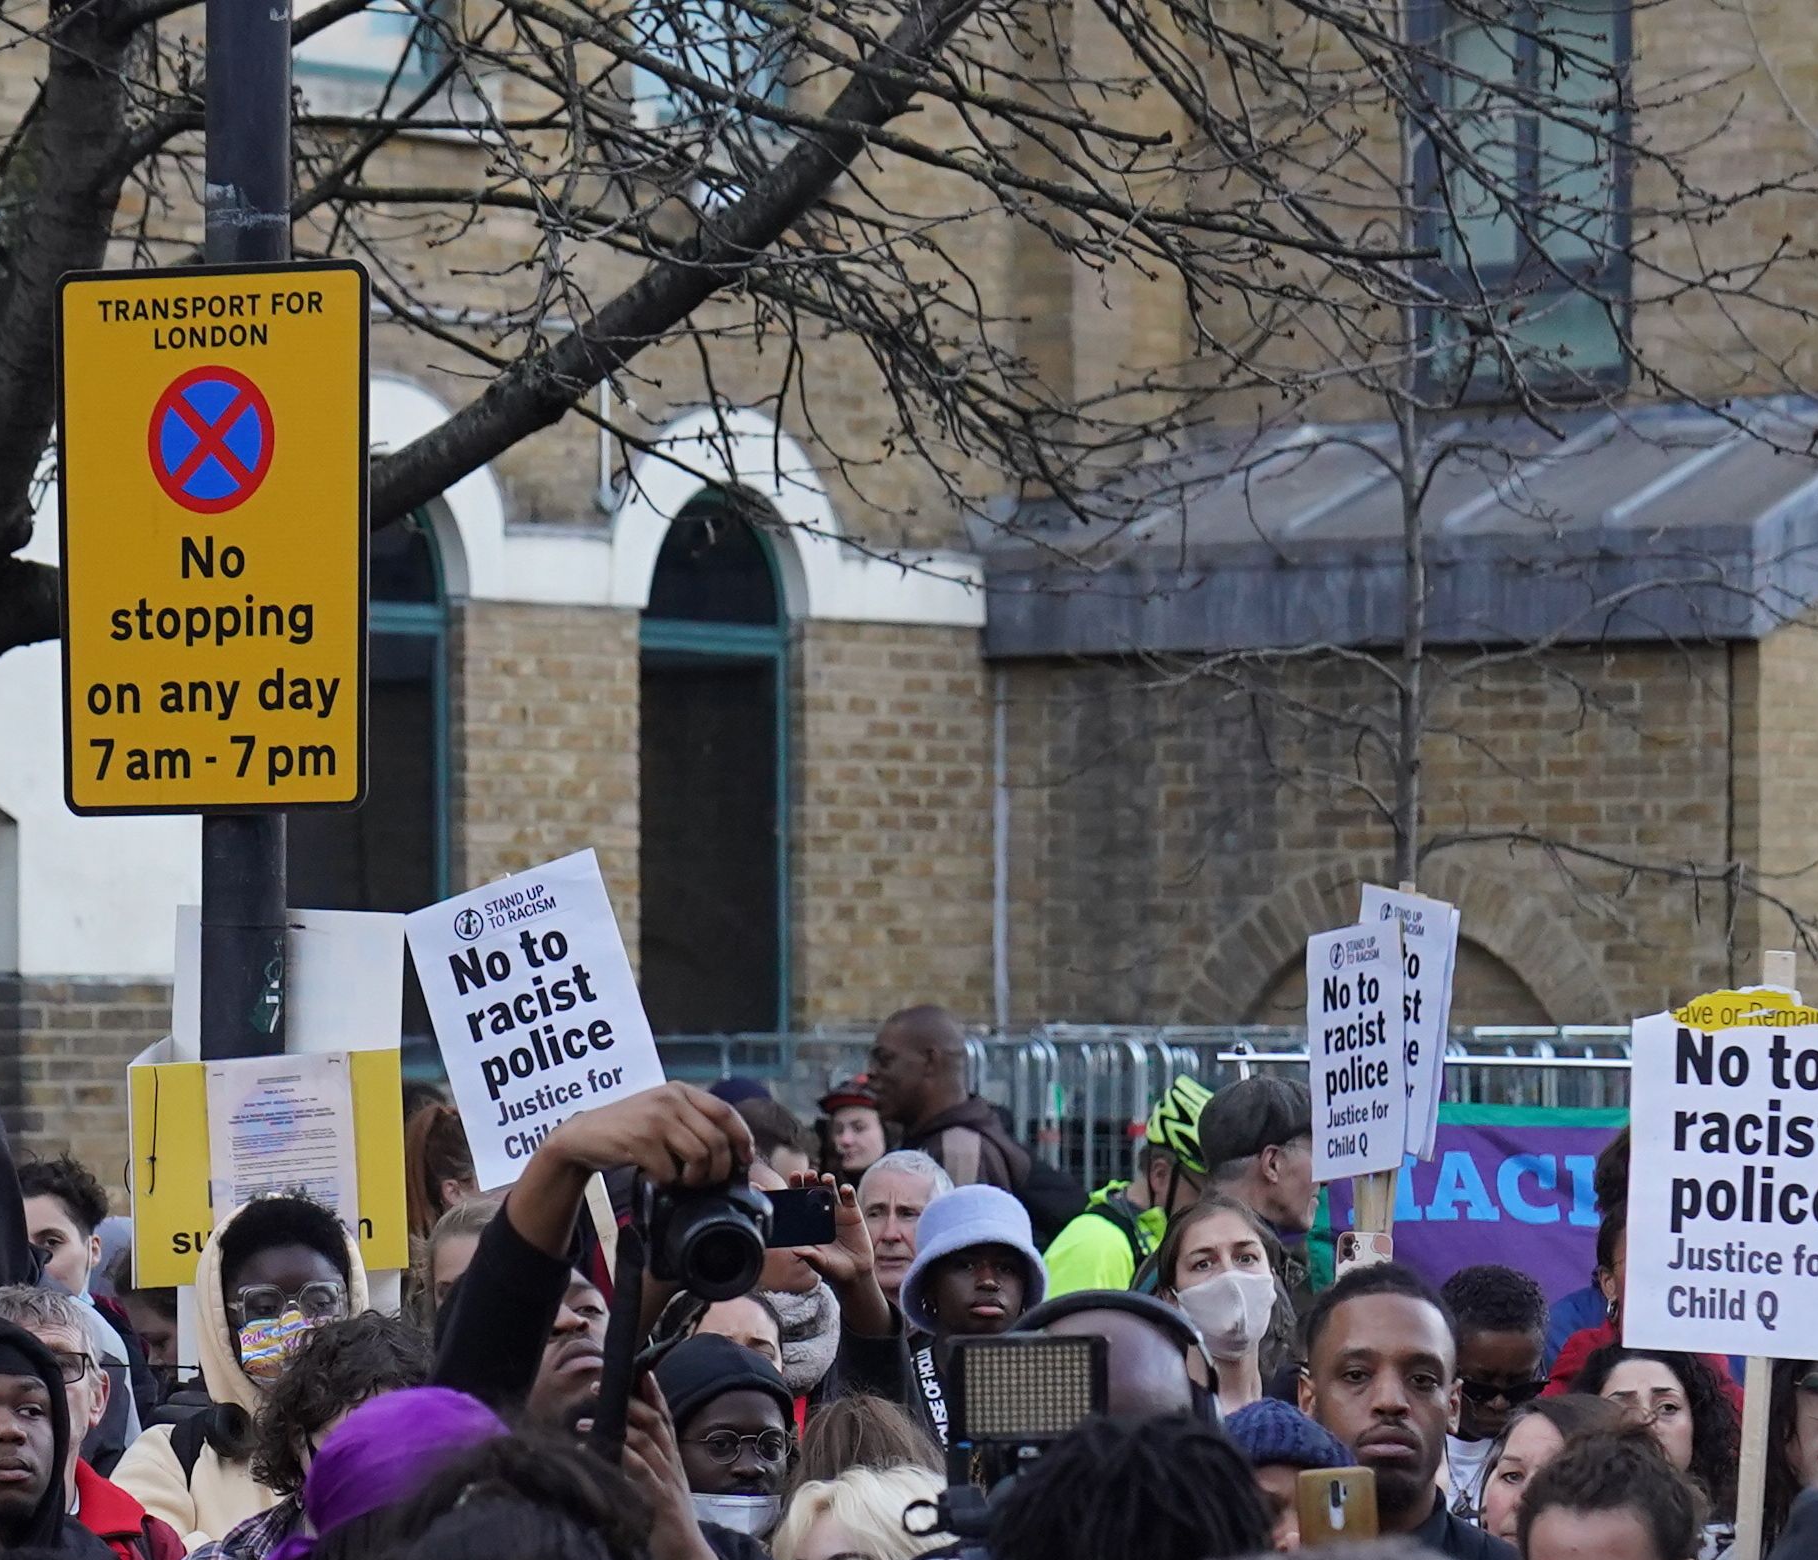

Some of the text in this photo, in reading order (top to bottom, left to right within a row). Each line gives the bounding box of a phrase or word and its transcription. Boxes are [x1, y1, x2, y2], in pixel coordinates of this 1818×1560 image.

[98, 292, 322, 322] TRANSPORT FOR
[155, 324, 267, 349] LONDON
[182, 536, 244, 578] No
[111, 594, 313, 646] stopping
[88, 668, 340, 720] on any day
[485, 885, 543, 915] STAND UP
[488, 897, 556, 928] TO RACISM
[449, 930, 567, 995] No to
[467, 964, 597, 1043] racist
[1324, 973, 1379, 1012] No to
[1325, 1011, 1385, 1055] racist
[1721, 1007, 1739, 1025] or
[481, 1020, 614, 1104] police
[1676, 1028, 1749, 1087] No
[498, 1067, 622, 1126] Justice for
[1326, 1055, 1388, 1106] police
[1327, 1100, 1389, 1128] Justice for
[1328, 1133, 1367, 1158] Child Q
[1668, 1238, 1782, 1274] Justice
[1668, 1286, 1778, 1330] Child Q
